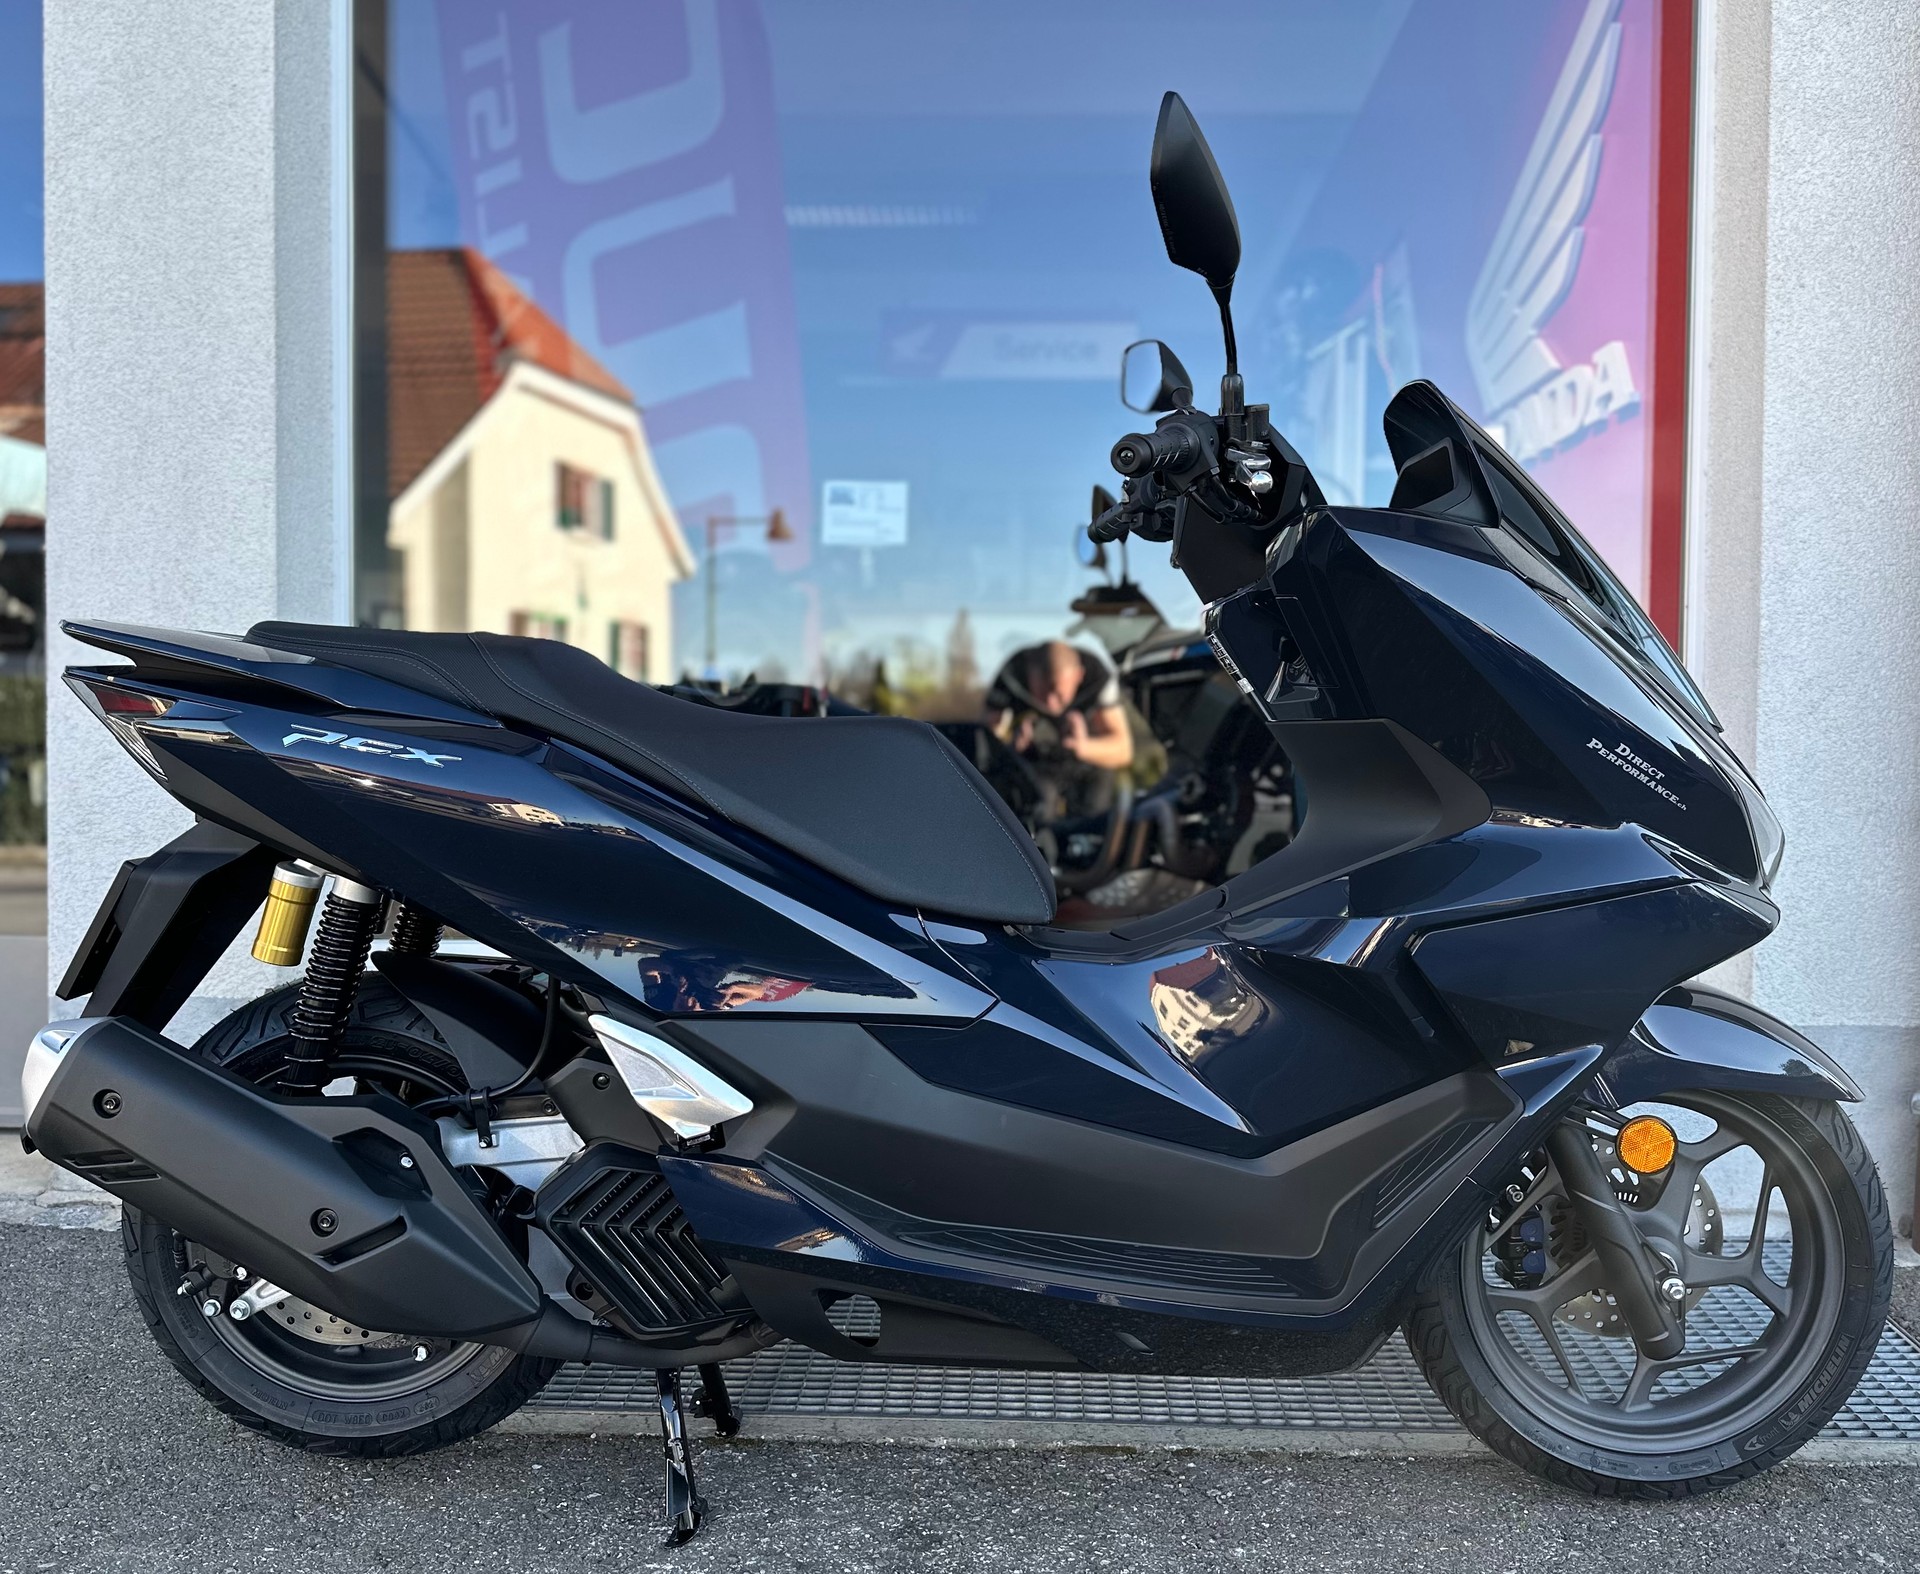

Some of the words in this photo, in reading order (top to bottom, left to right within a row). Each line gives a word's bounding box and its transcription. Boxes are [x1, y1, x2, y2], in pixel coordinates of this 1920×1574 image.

[282, 724, 462, 768] PCX
[1614, 742, 1665, 780] DIRECT
[1797, 1334, 1851, 1413] MICHELIN
[1760, 1426, 1780, 1443] front
